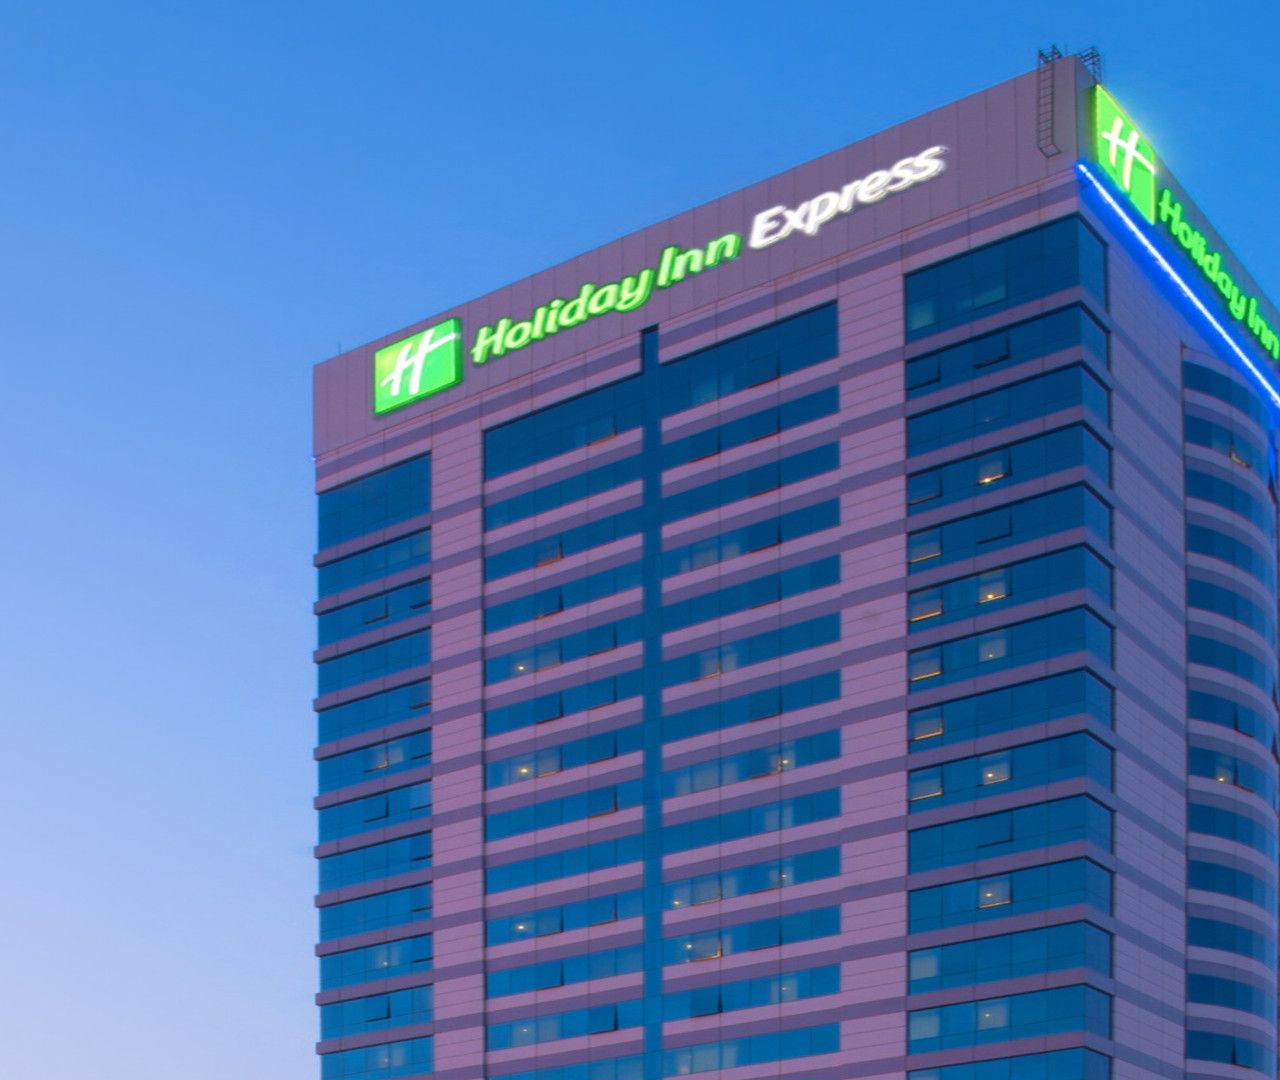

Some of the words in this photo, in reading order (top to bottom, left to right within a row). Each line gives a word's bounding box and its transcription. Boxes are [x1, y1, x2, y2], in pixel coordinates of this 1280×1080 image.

[471, 267, 654, 364] Holiday
[658, 232, 742, 287] Inn
[749, 145, 948, 250] Express
[1159, 189, 1247, 321] Holiday
[1247, 299, 1280, 359] Inn
